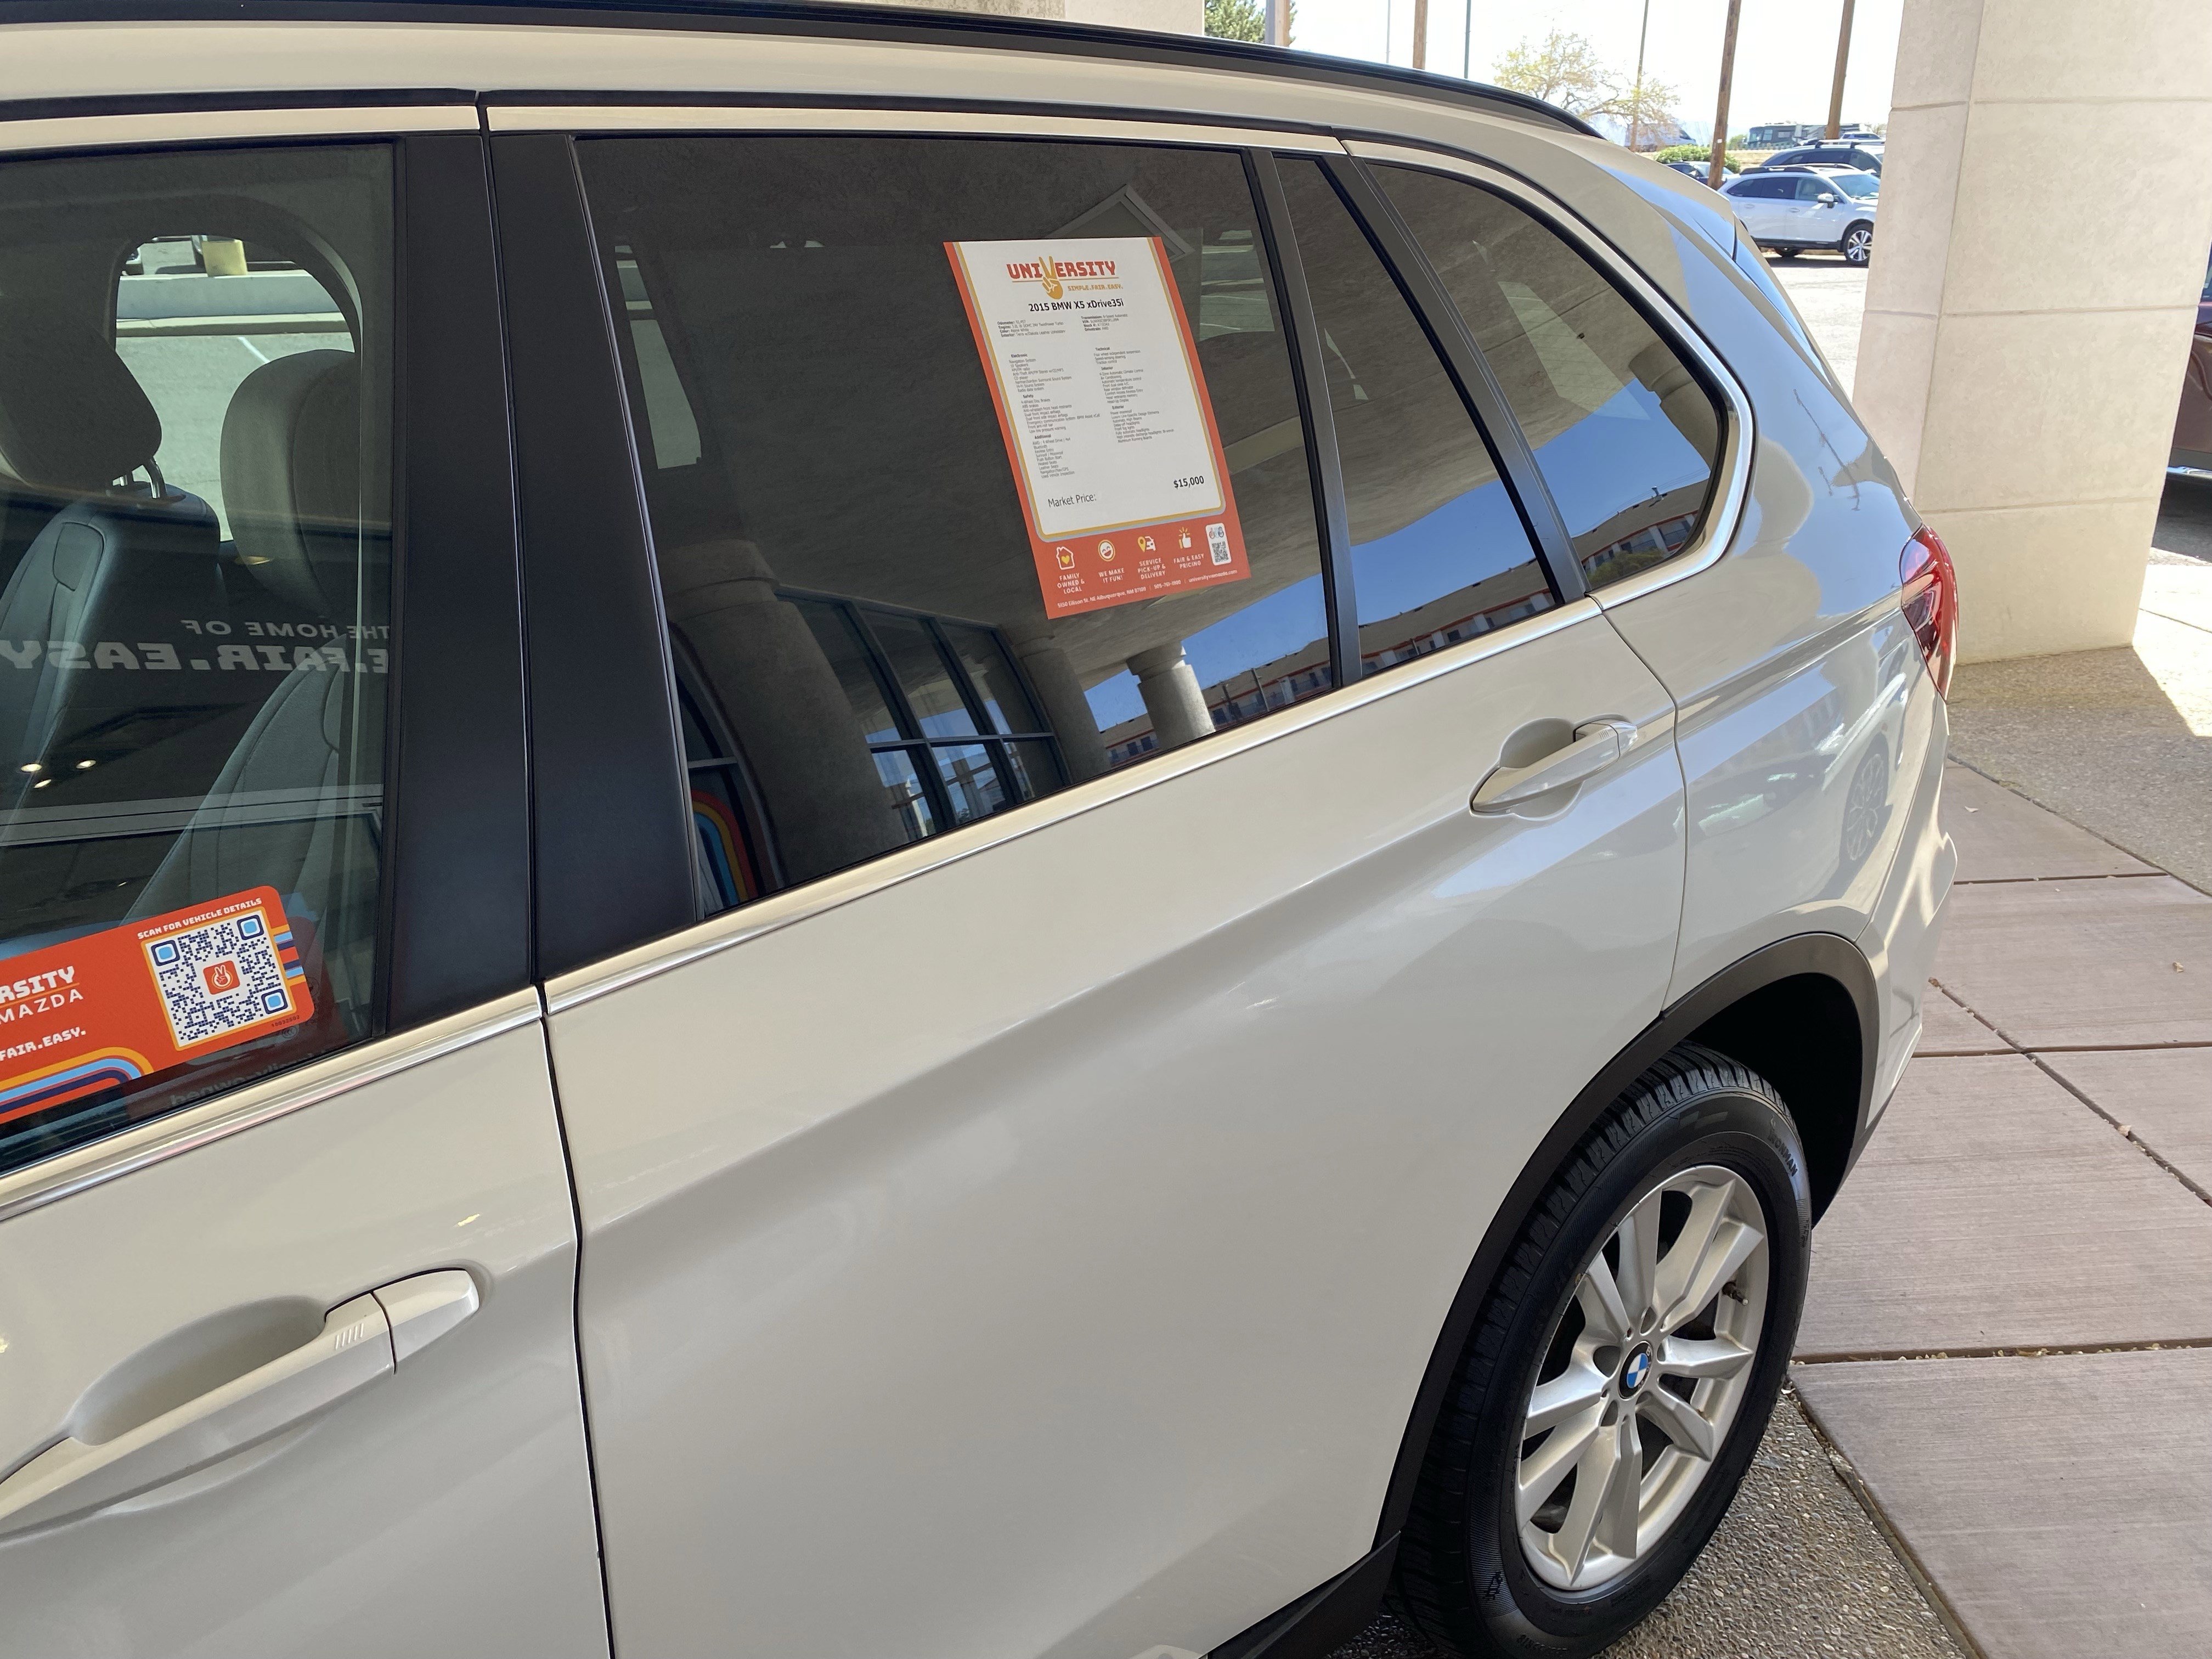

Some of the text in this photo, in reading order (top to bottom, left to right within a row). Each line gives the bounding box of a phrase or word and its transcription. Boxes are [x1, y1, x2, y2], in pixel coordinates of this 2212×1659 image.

[1029, 298, 1124, 312] 2015 BMW X5 xDrive35i
[1173, 476, 1204, 489] $15,000
[1048, 494, 1097, 507] Market Price:
[1139, 557, 1162, 567] SERVICE
[1180, 561, 1201, 569] PRICING
[1137, 565, 1160, 574] PICK-UP
[1059, 573, 1080, 582] FAMILY
[1141, 571, 1166, 579] DELIVERY
[1057, 580, 1079, 589] OWNED
[137, 898, 262, 939] SCAN FOR VEHICLE DETAILS
[0, 989, 83, 1025] MAZDA
